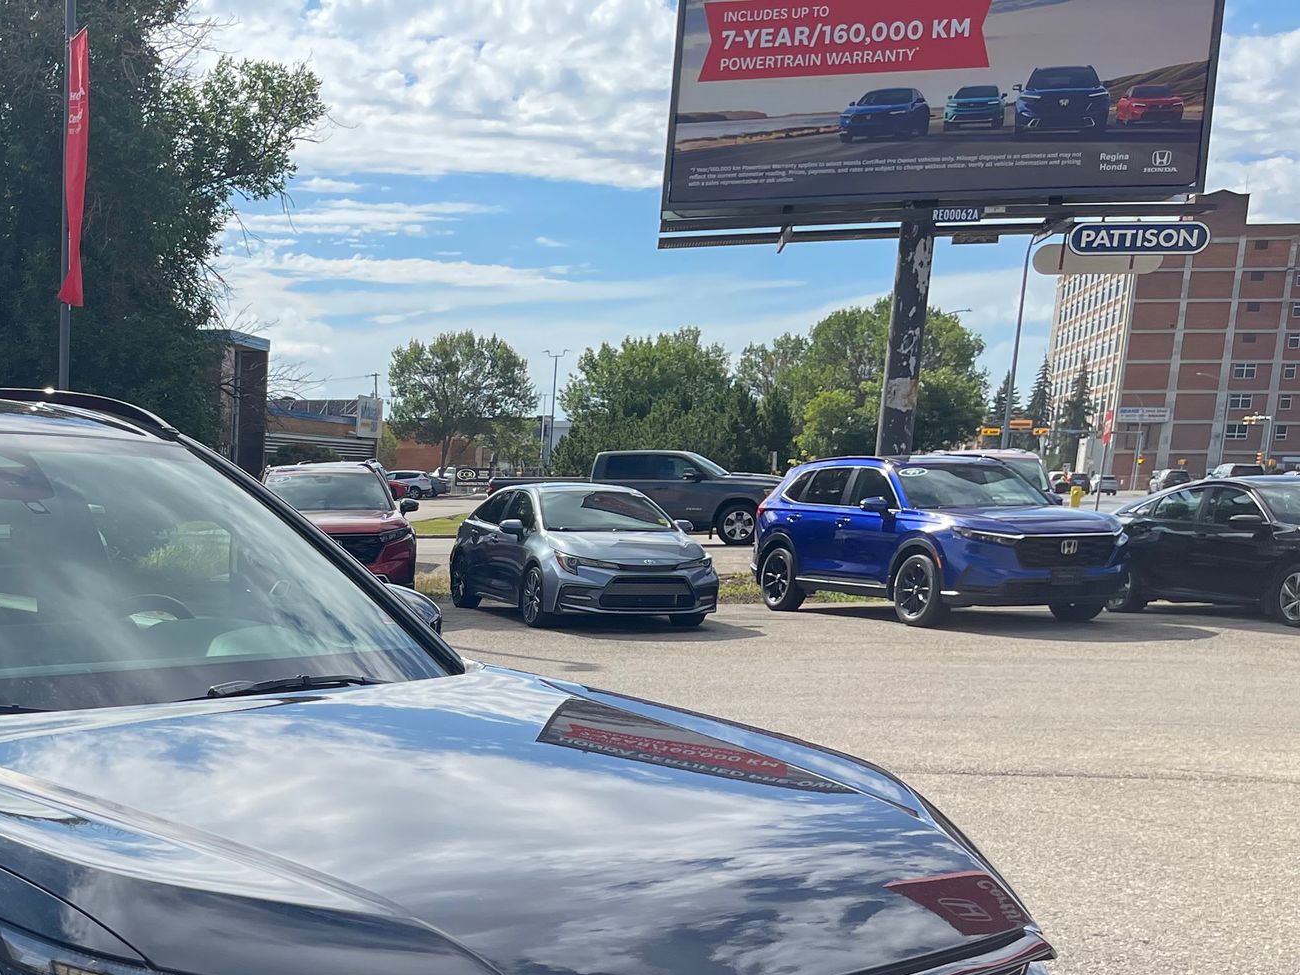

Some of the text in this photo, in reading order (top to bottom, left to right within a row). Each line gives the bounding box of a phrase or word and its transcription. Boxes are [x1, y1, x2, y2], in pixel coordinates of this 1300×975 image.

[723, 5, 830, 22] INCLUDES UP TO
[721, 18, 971, 51] 7-YEAR/160,000 KM
[719, 52, 822, 72] POWERTRAIN
[1100, 153, 1129, 162] Regina
[1100, 163, 1128, 171] Honda
[932, 209, 979, 221] RE00062A
[1080, 228, 1200, 248] PATTISON
